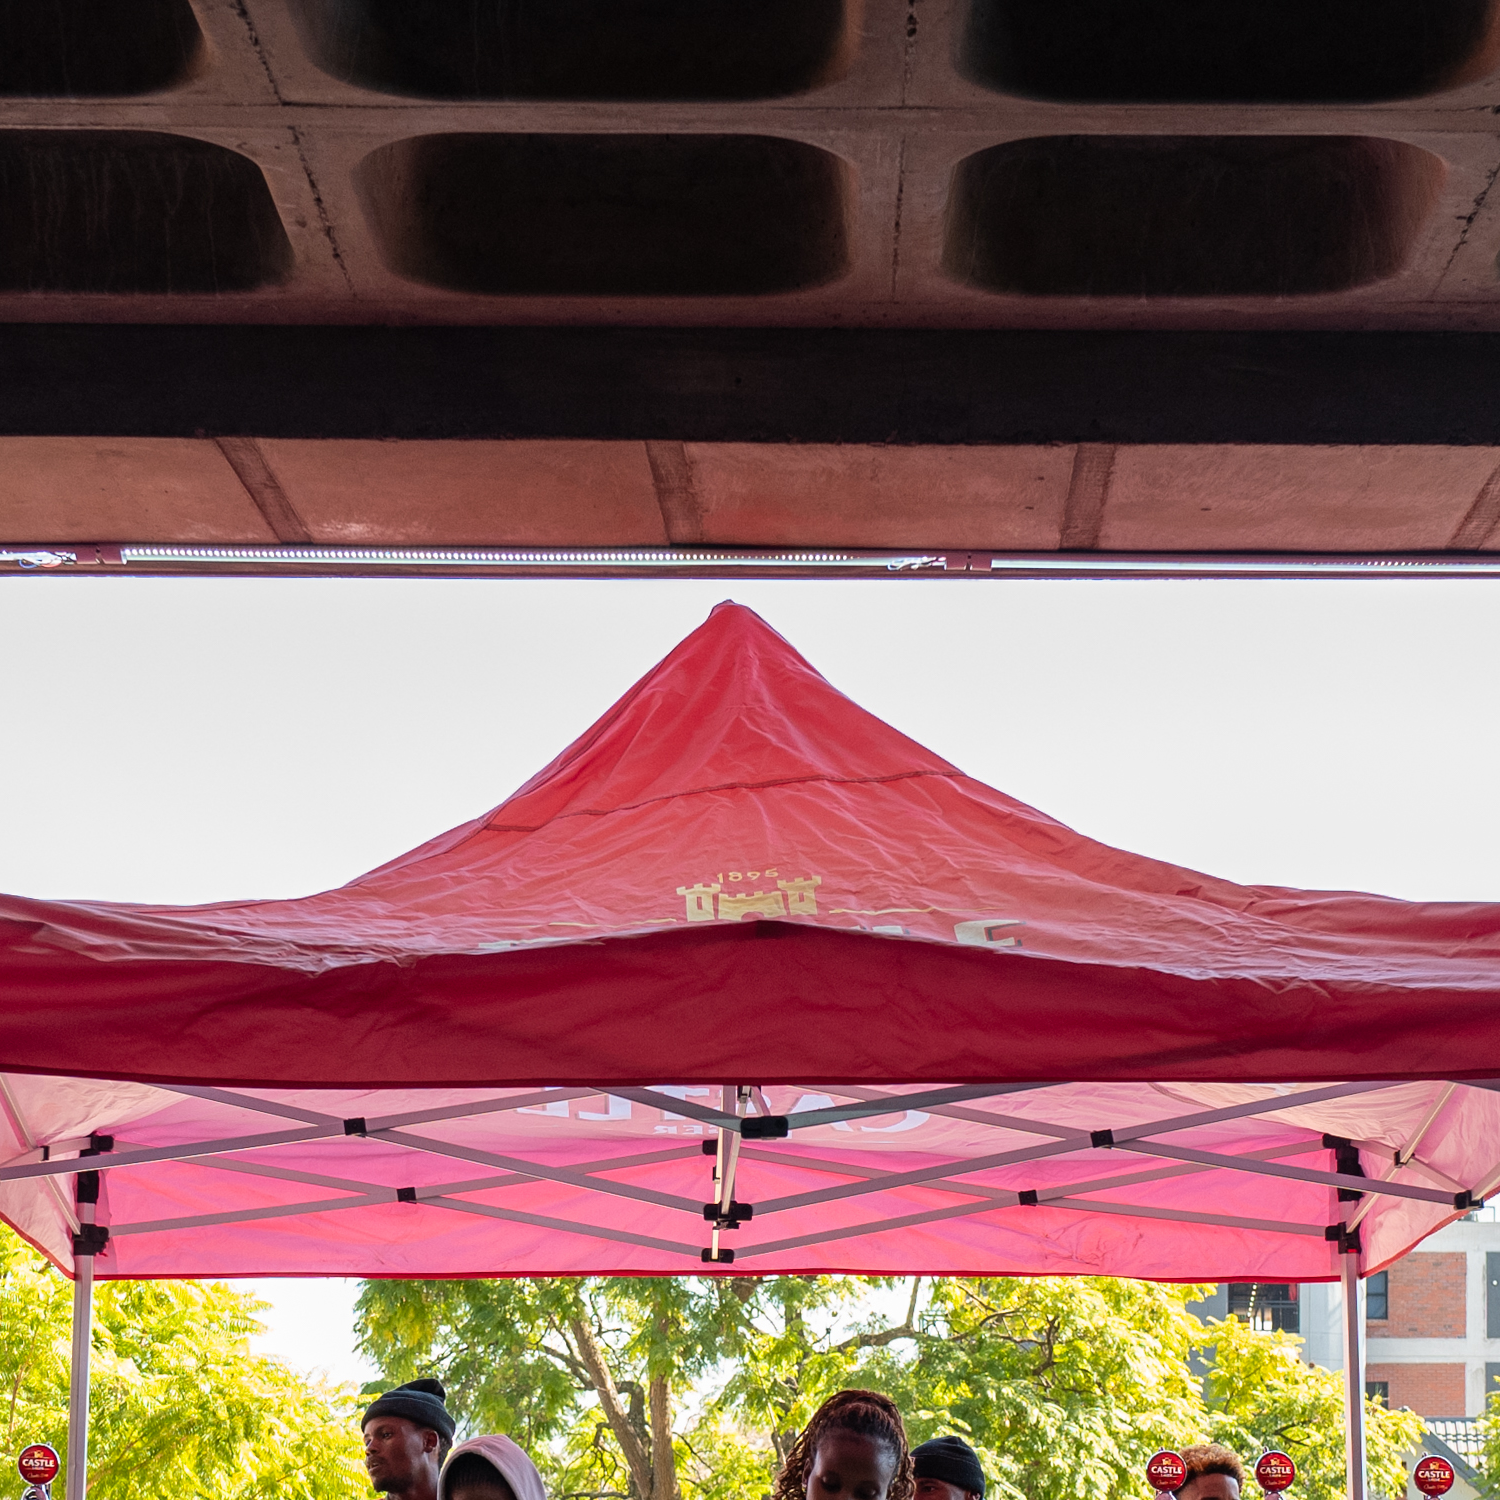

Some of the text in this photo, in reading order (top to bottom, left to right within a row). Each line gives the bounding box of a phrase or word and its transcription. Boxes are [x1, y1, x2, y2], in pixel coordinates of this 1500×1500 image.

[716, 867, 780, 885] 1895
[22, 1458, 55, 1468] CASTLE
[1151, 1466, 1183, 1474] CASTLE
[1259, 1466, 1291, 1475] CASTLE
[1418, 1470, 1450, 1478] CASTLE
